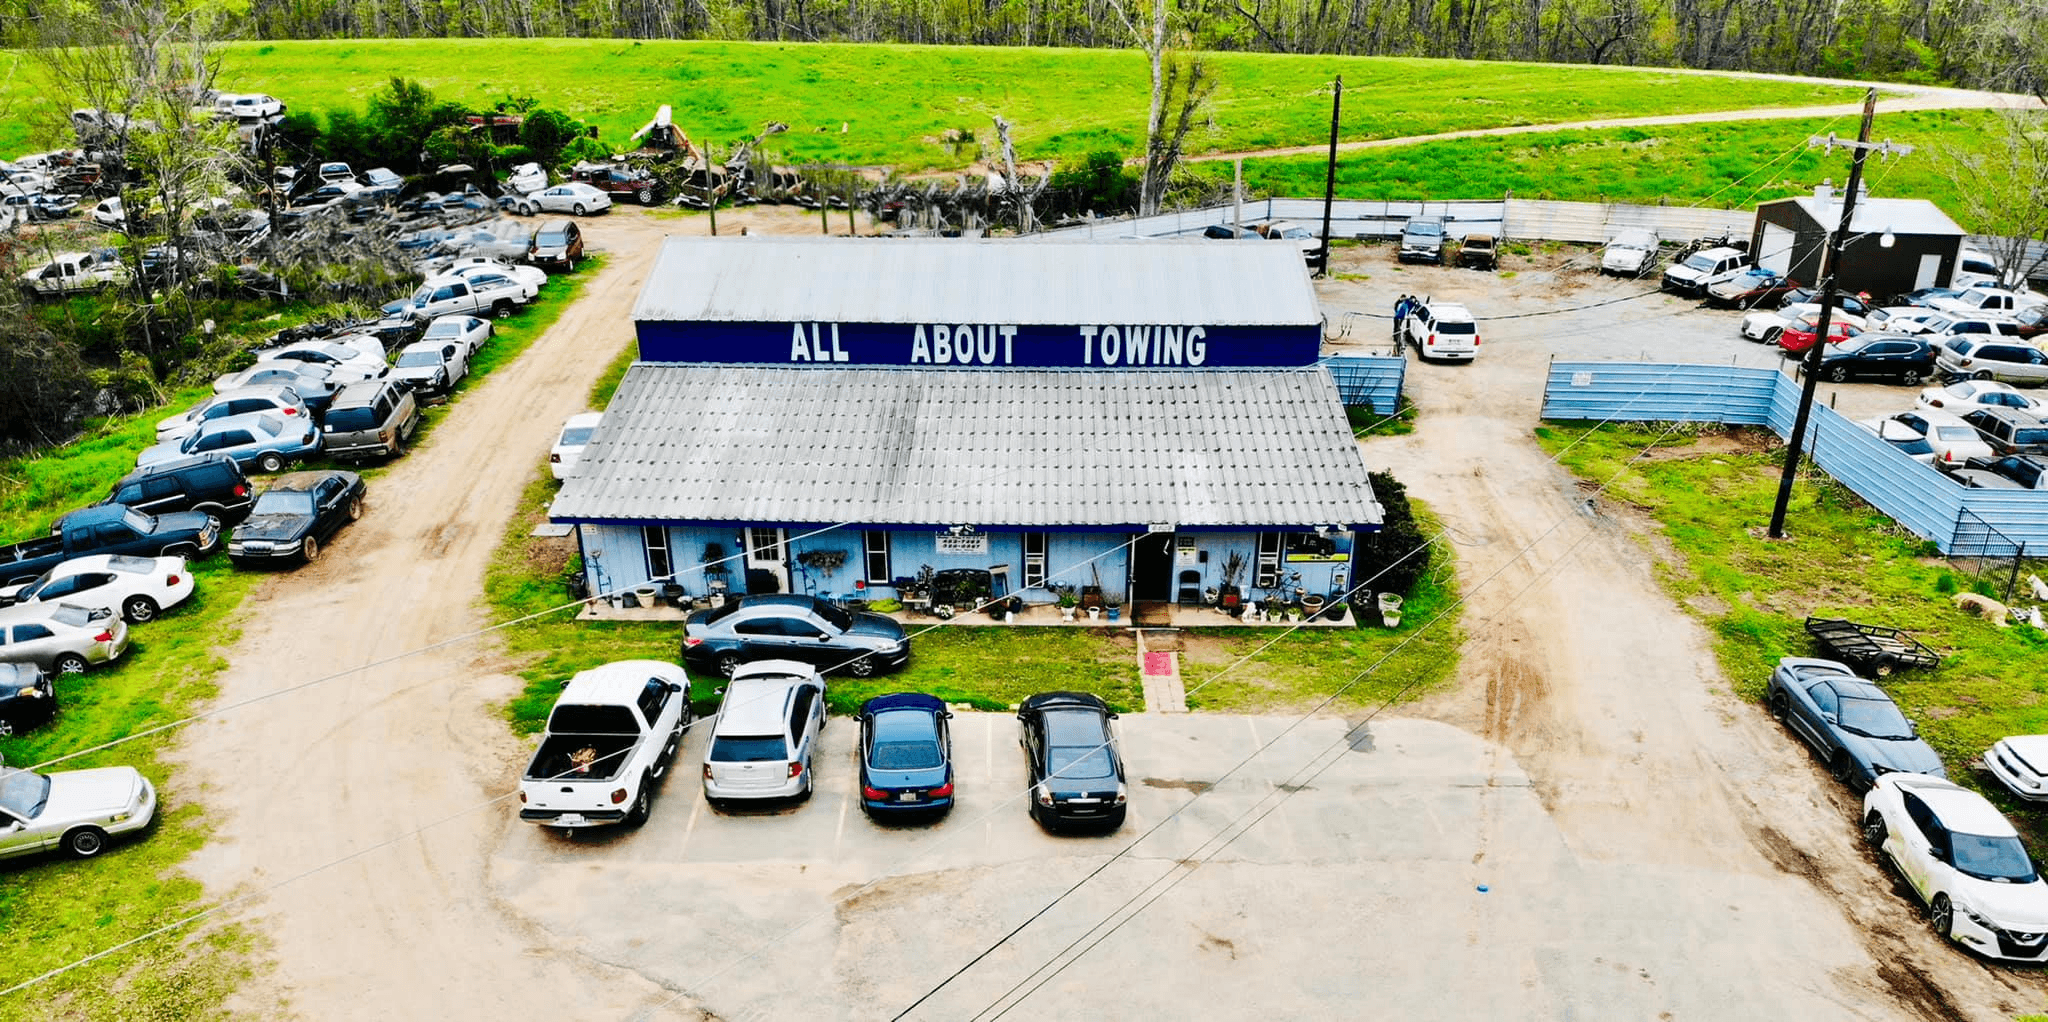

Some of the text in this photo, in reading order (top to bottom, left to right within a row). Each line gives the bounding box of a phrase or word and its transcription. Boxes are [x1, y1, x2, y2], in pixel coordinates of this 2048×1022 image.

[791, 323, 1206, 365] ALL ABOUT TOWING
